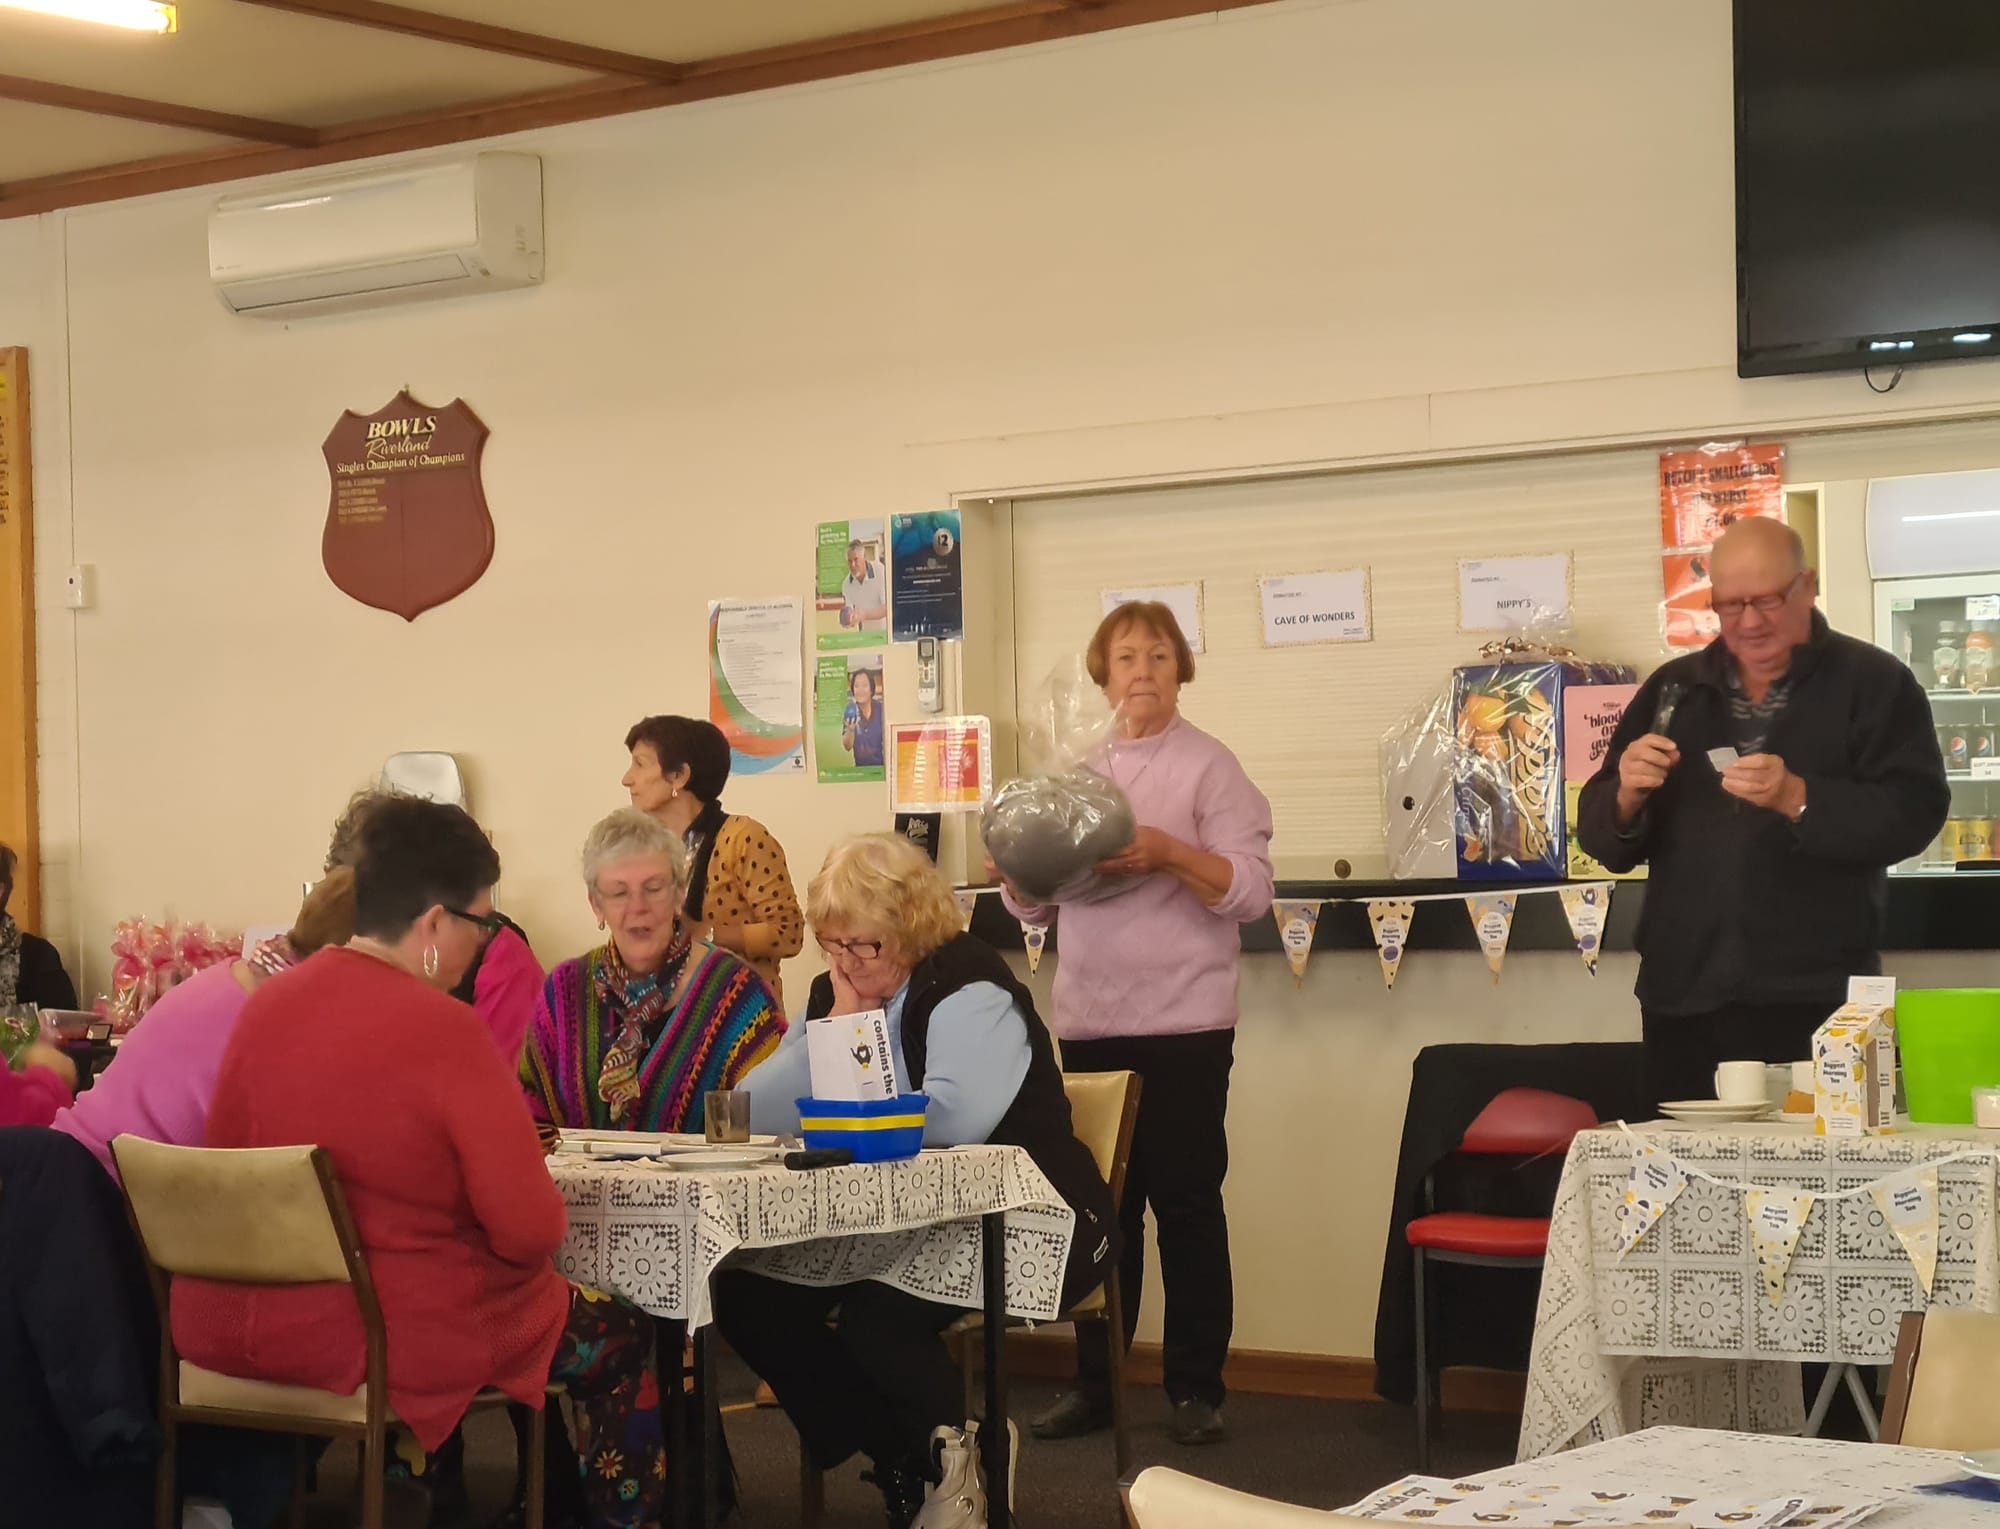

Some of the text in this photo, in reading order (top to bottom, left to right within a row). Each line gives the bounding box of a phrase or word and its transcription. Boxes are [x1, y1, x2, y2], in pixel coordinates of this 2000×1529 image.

[367, 416, 437, 438] BOWLS
[365, 434, 432, 459] Riverland
[336, 452, 465, 474] Singles Champion of Champions
[1274, 611, 1355, 625] CAVE OF WONDERS
[873, 1019, 893, 1095] contains the
